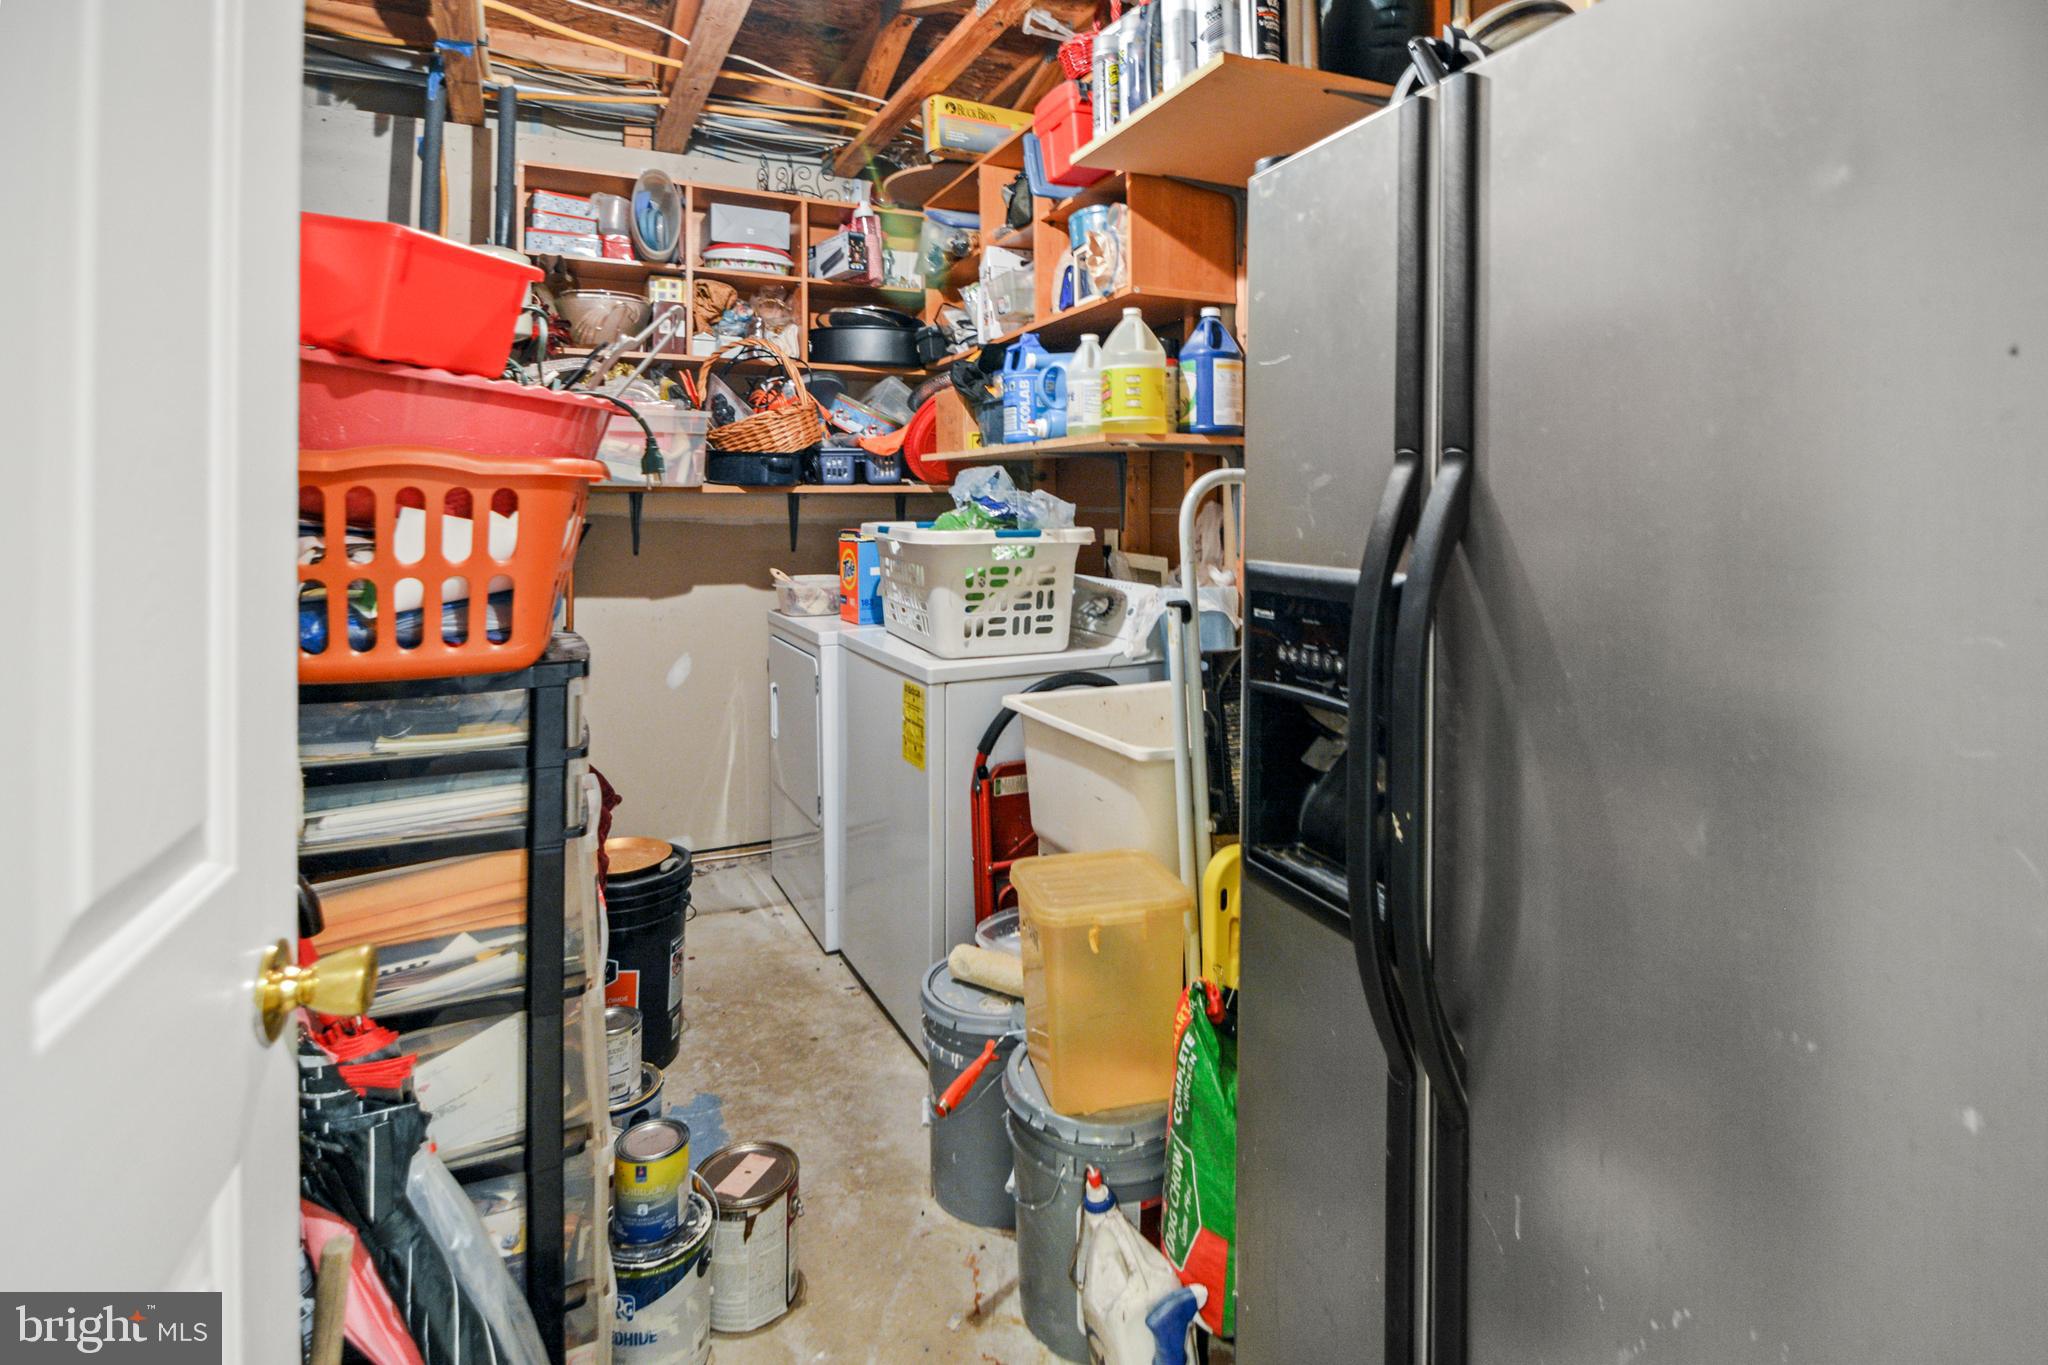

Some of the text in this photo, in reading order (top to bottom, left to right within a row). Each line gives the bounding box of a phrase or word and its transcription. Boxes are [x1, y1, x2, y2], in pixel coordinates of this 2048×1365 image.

[843, 558, 856, 580] Tide
[1173, 1031, 1196, 1125] COMPLETE
[1183, 1052, 1198, 1111] CHICKEN
[1165, 1142, 1184, 1258] DOG CHOW
